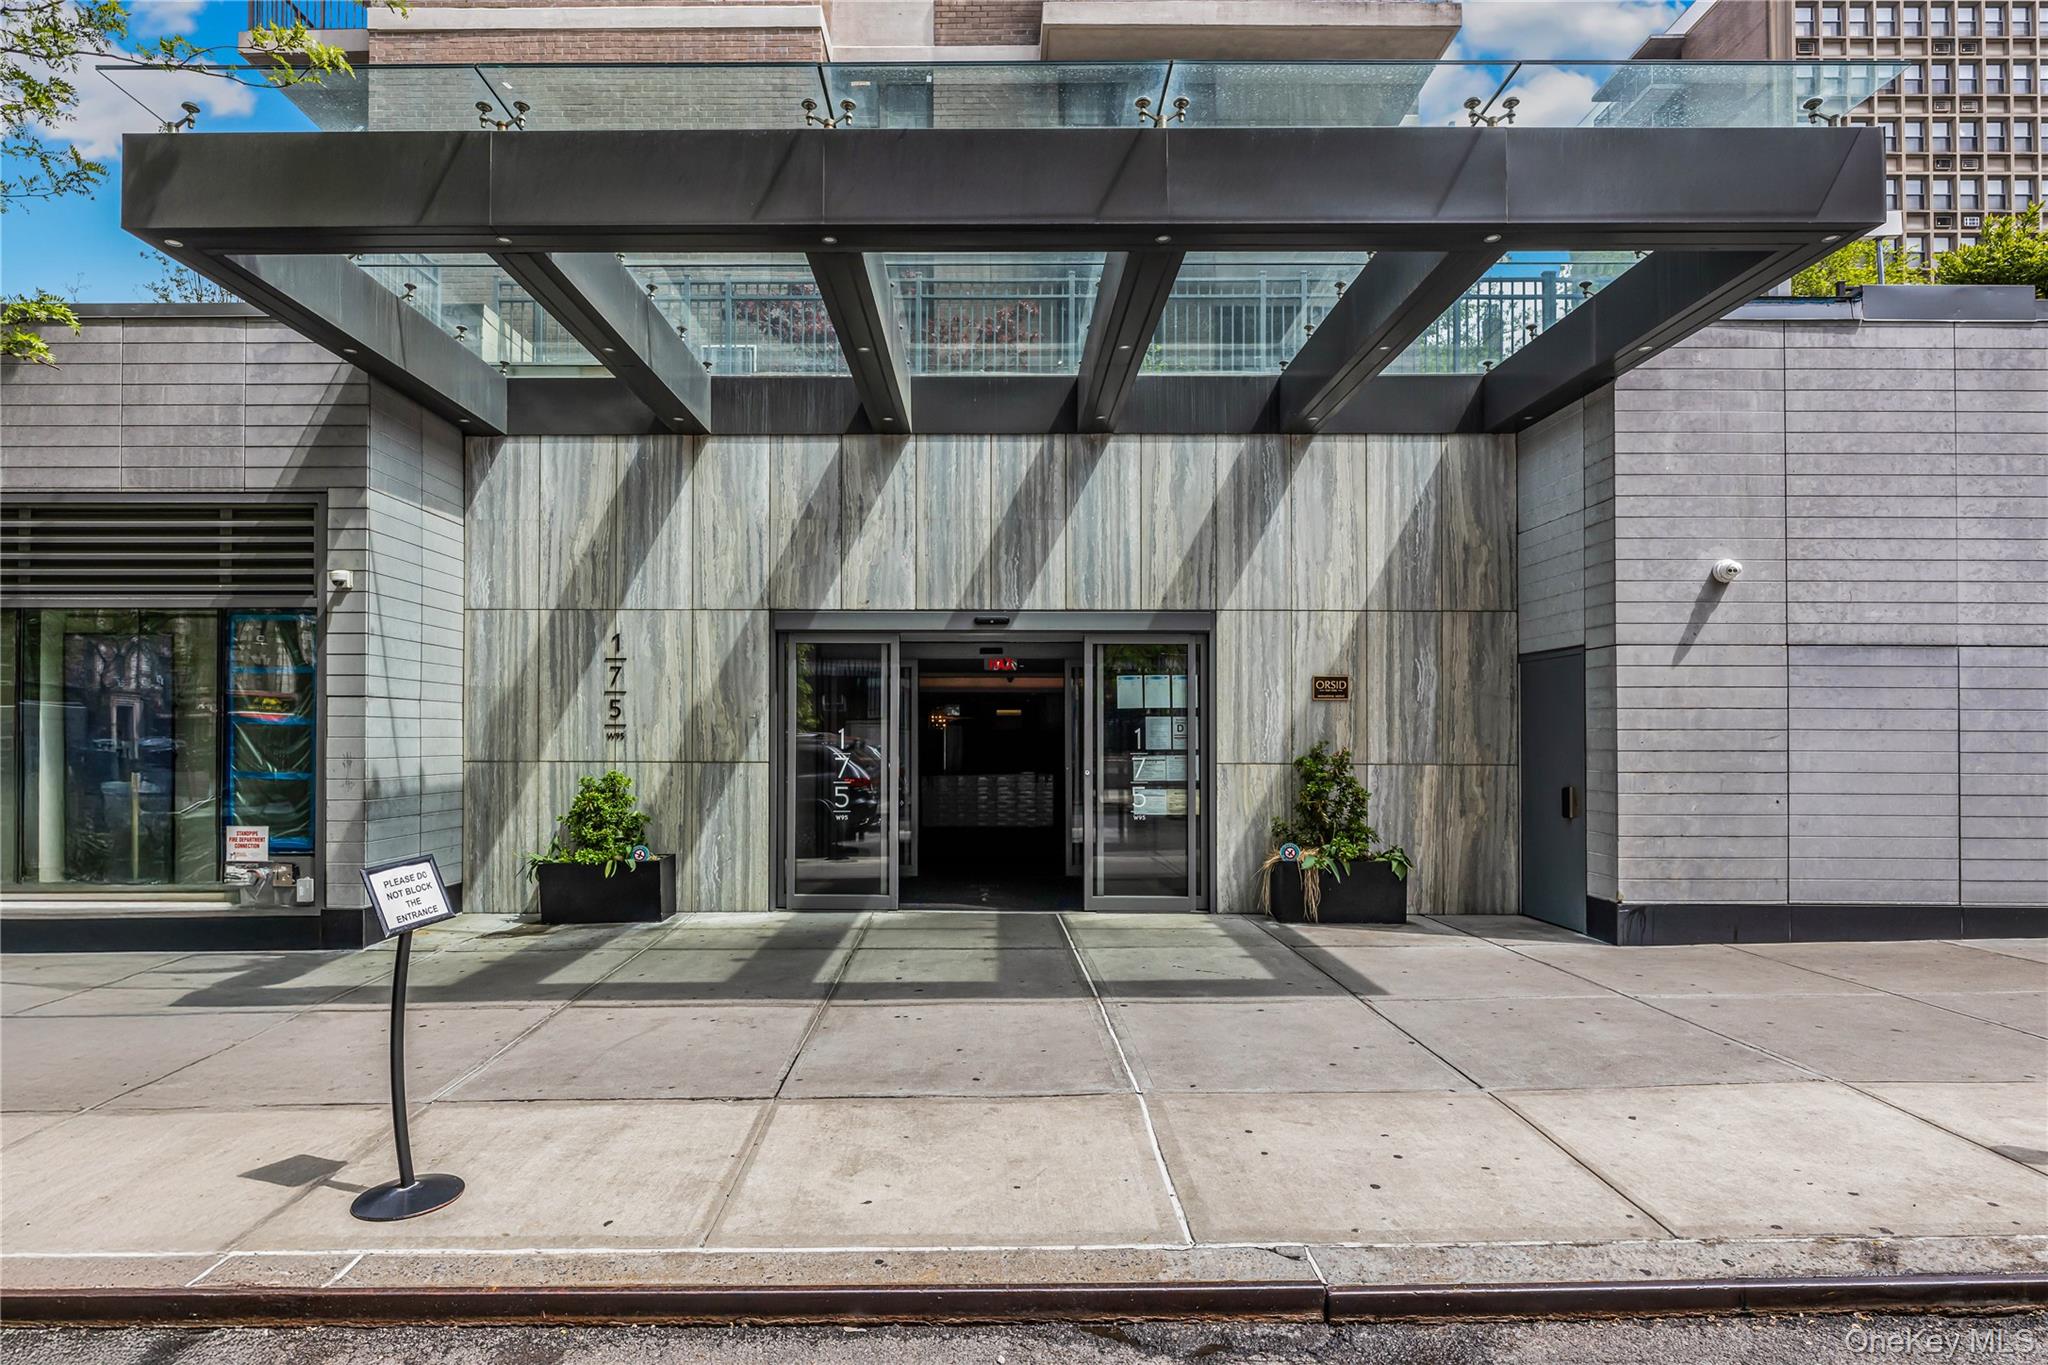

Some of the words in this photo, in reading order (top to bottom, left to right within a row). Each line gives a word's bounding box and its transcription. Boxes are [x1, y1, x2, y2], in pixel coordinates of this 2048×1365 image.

[1315, 680, 1347, 690] ORSID
[606, 732, 625, 741] W95
[383, 874, 415, 888] PLEASE
[386, 889, 404, 901] NOT
[405, 881, 433, 896] BLOCK
[405, 896, 422, 908] THE
[396, 905, 438, 923] ENTRANCE
